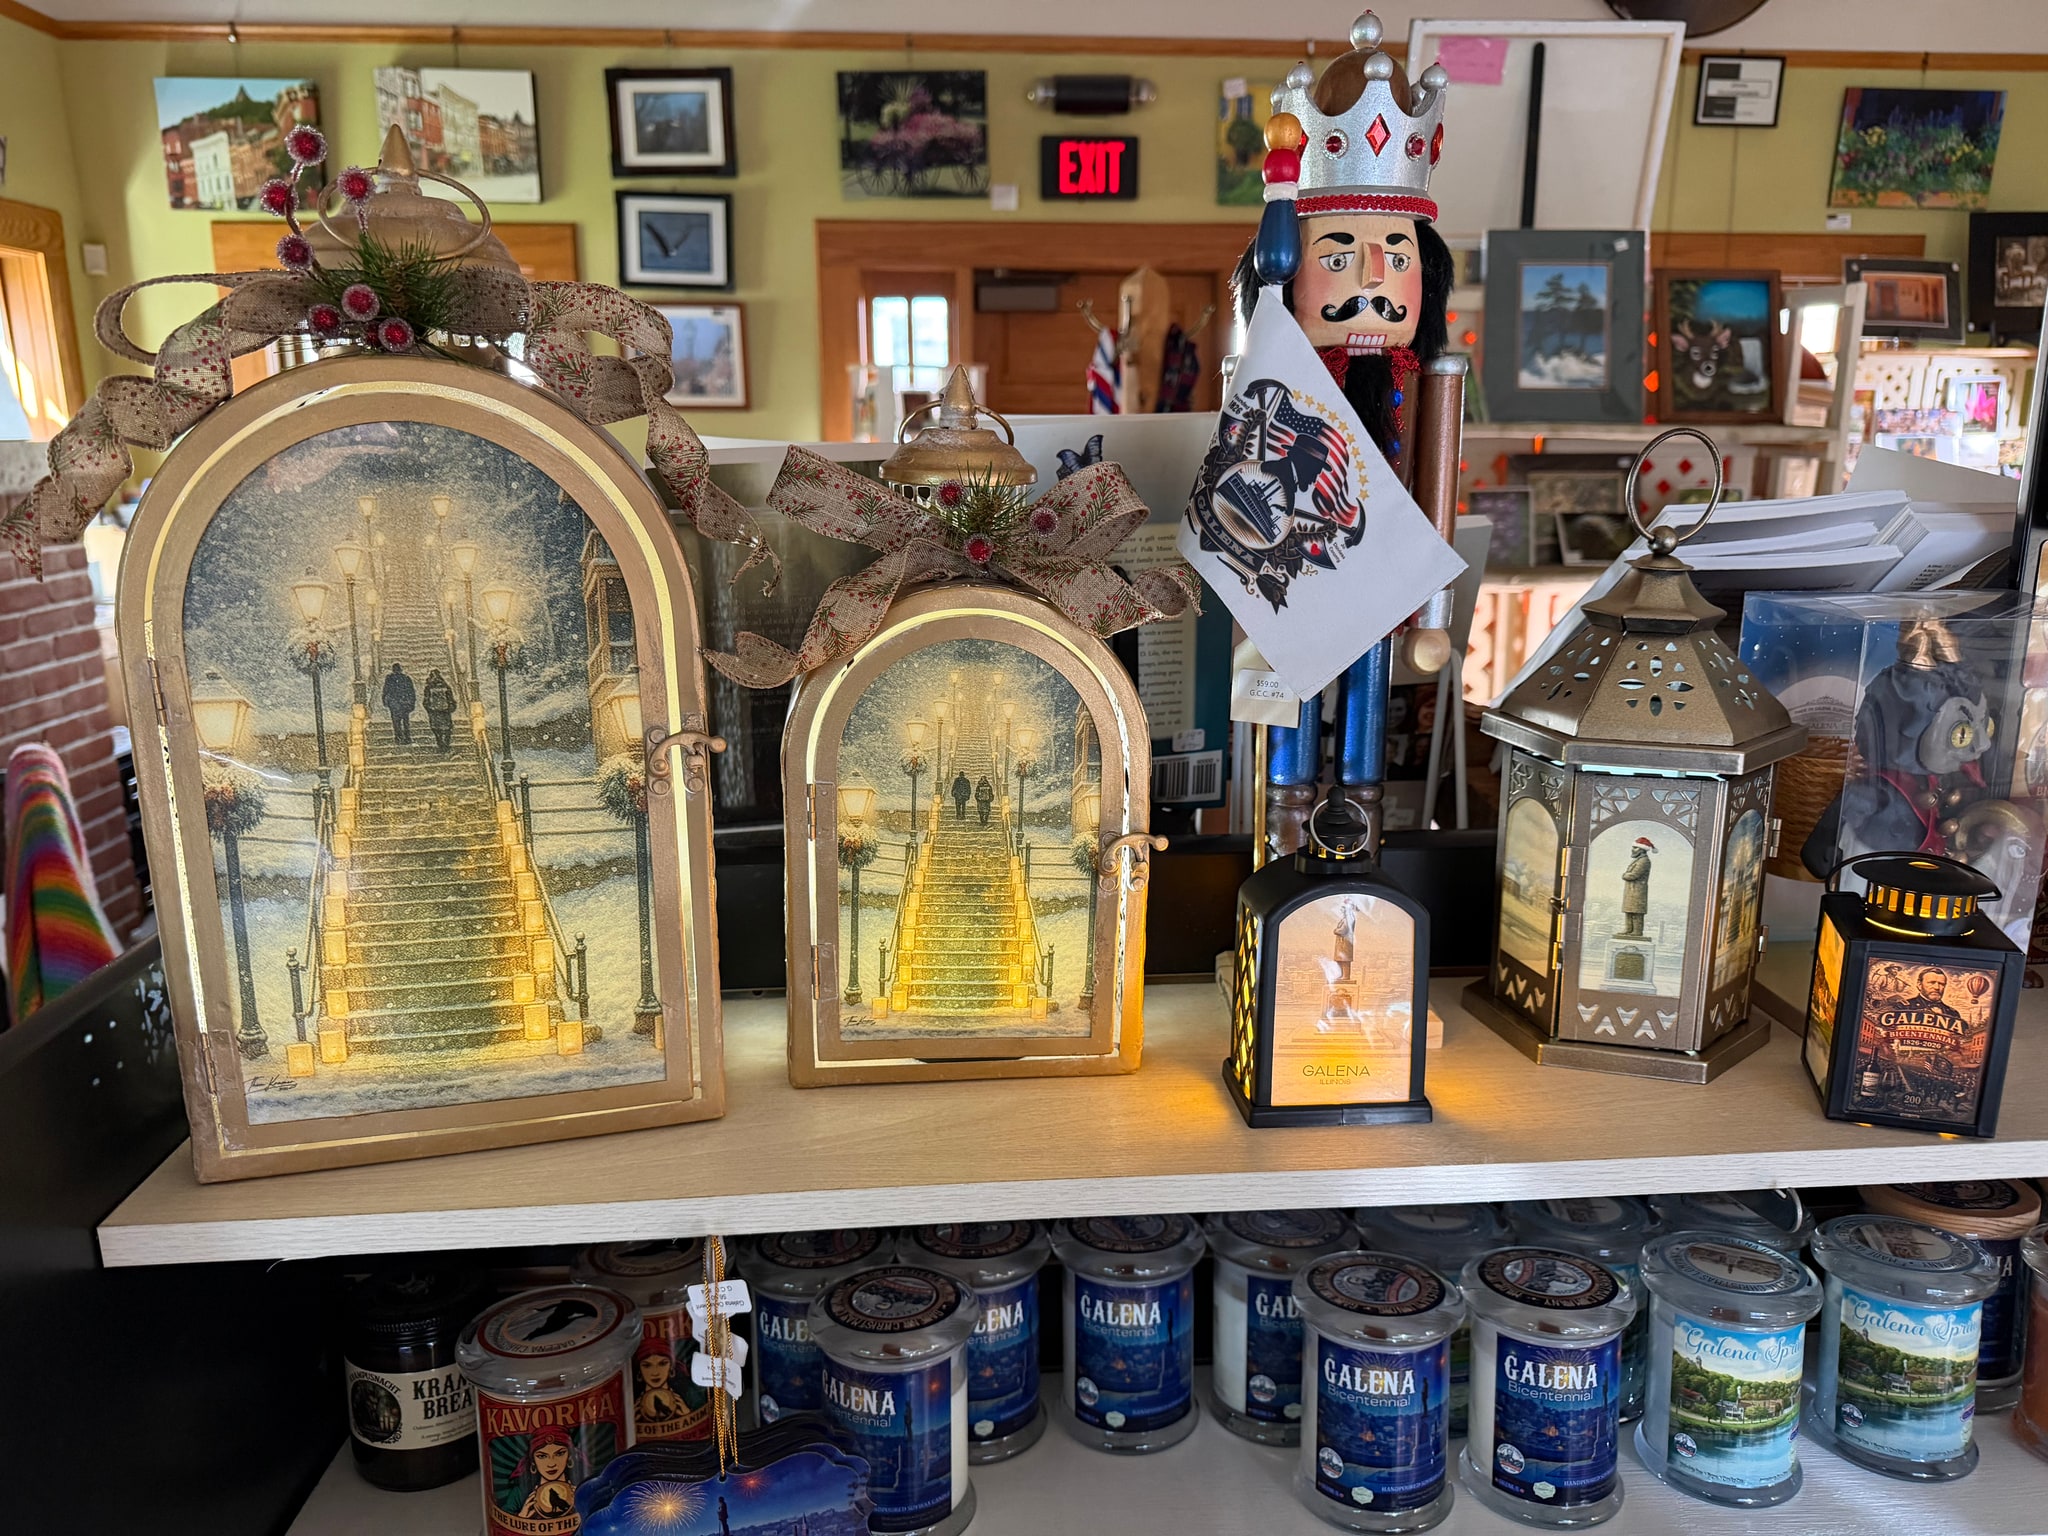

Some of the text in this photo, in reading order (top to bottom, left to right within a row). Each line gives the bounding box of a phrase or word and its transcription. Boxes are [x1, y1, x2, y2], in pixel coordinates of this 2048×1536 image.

[1059, 141, 1126, 194] EXIT
[1227, 400, 1242, 415] 1826
[1196, 495, 1256, 567] GALENA
[1256, 680, 1279, 689] $59.00
[1271, 691, 1285, 699] #74
[1881, 1012, 1964, 1035] GALENA
[1889, 1030, 1957, 1046] BICENTENNIAL
[1903, 1039, 1942, 1049] 1826-2026
[1302, 1064, 1371, 1077] GALENA
[1904, 1094, 1921, 1105] 200
[1080, 1294, 1162, 1327] GALENA
[1853, 1300, 1926, 1337] Galena
[760, 1311, 815, 1342] GALE
[1083, 1319, 1159, 1338] Bicentennial
[1684, 1327, 1759, 1361] Galena
[1323, 1357, 1416, 1396] GALENA
[1504, 1354, 1598, 1390] GALENA
[822, 1368, 897, 1416] GALENA
[1327, 1382, 1411, 1408] Bicentennial
[1508, 1379, 1594, 1403] Bicentennial
[485, 1391, 616, 1437] KAVORKA
[644, 1423, 657, 1435] OF
[659, 1418, 680, 1433] THE
[493, 1508, 579, 1533] THE LURE OF THE
